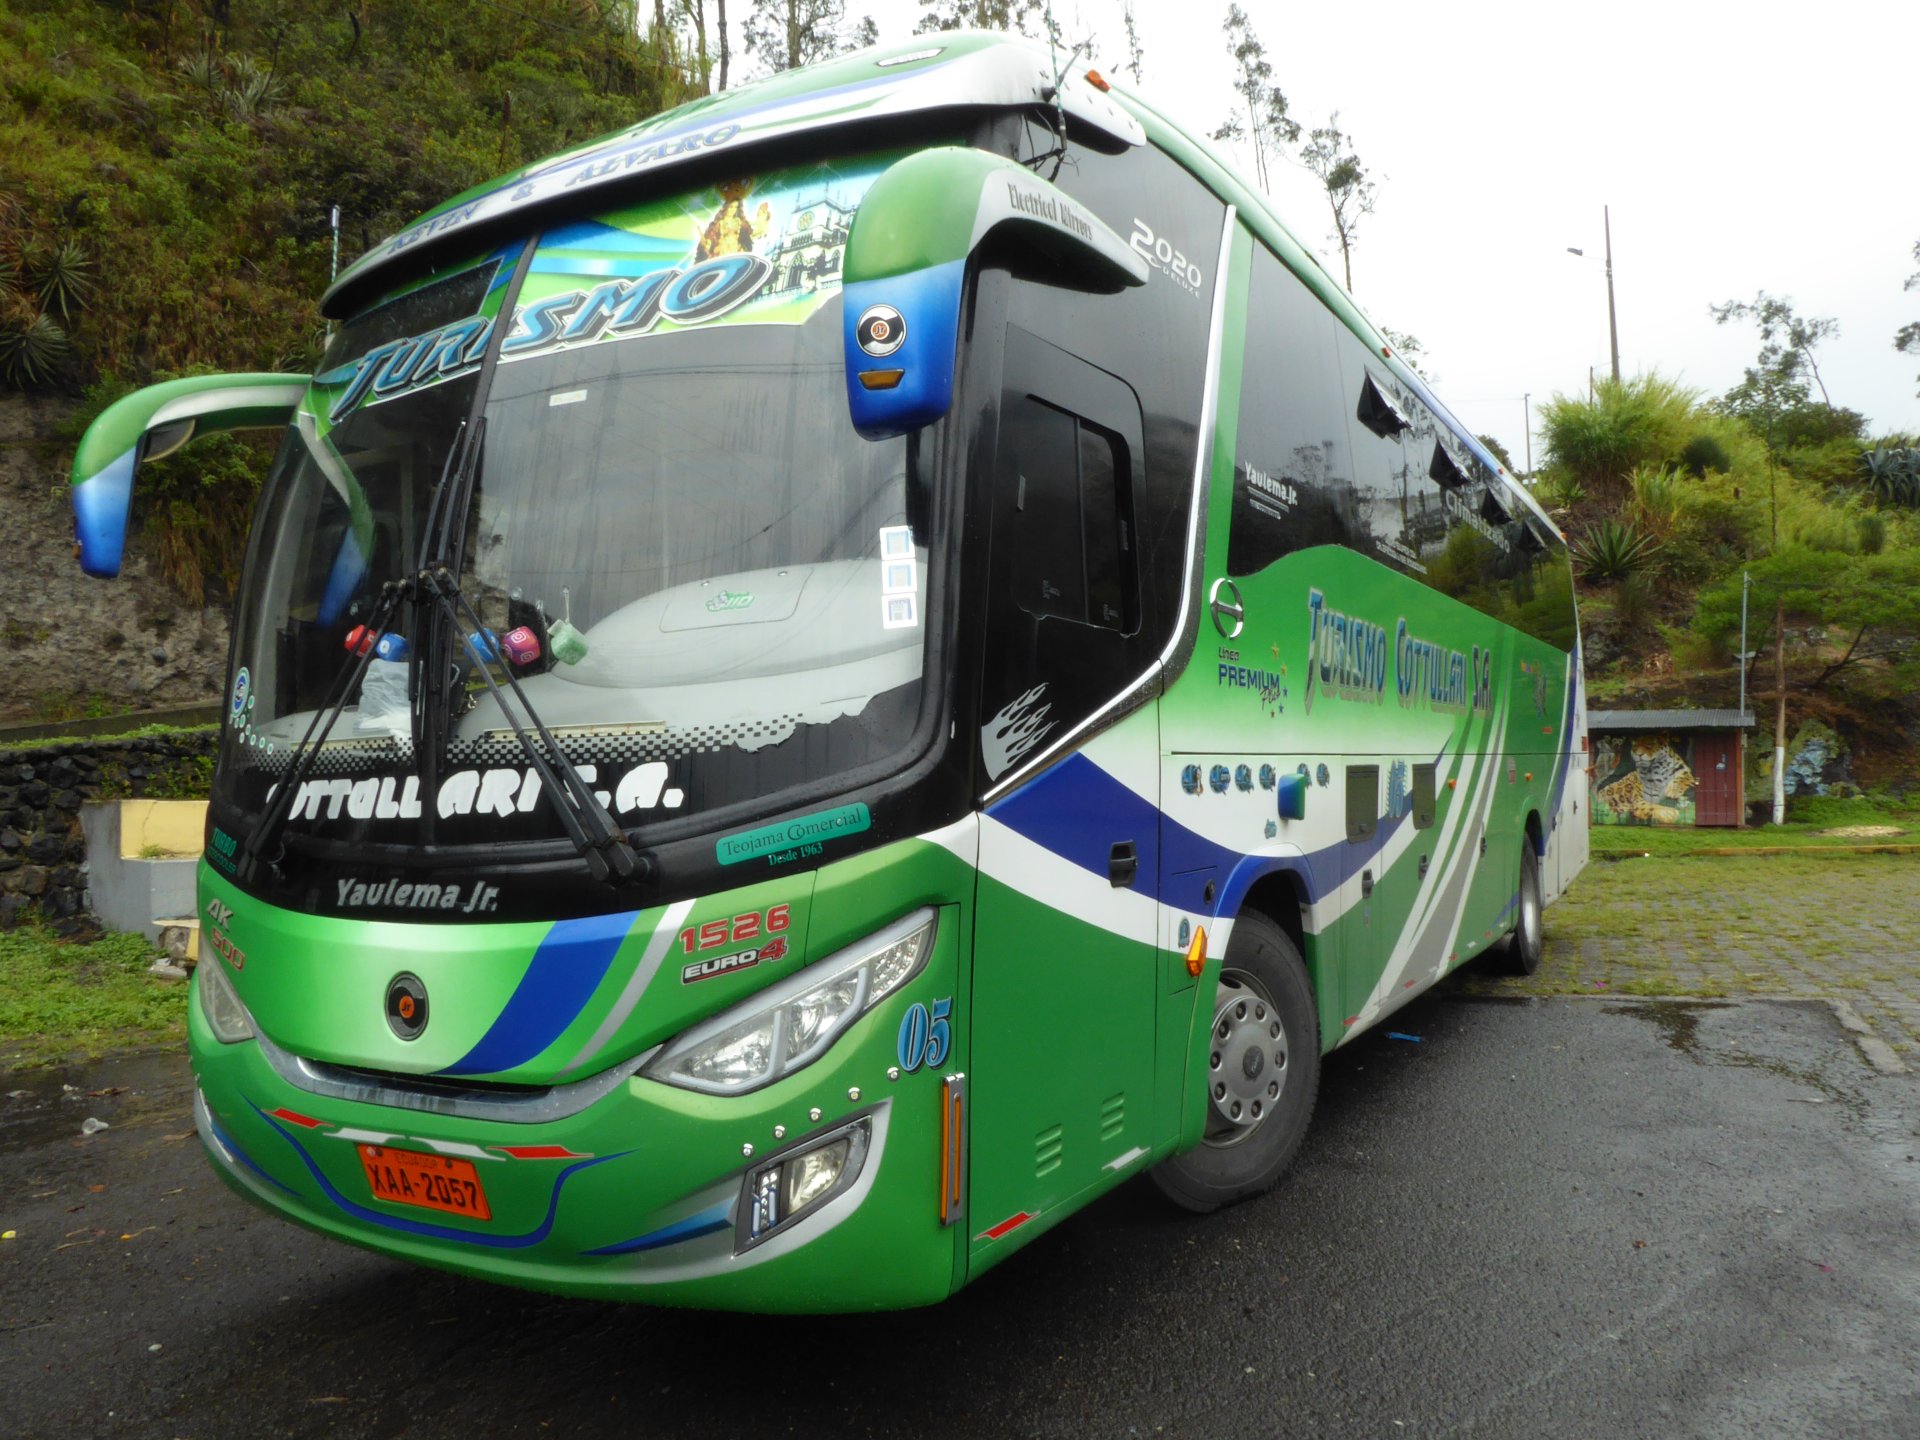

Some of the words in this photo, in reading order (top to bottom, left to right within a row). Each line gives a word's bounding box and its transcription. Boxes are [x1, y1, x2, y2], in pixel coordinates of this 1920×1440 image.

[511, 183, 536, 201] &
[565, 125, 742, 187] ALVARO
[1007, 183, 1058, 222] Electrical
[1130, 217, 1202, 288] 2020
[329, 253, 772, 425] TURISMO
[1245, 460, 1287, 501] Yaulema
[1304, 586, 1387, 710] TURISMO
[1218, 663, 1280, 692] PREMIUM
[723, 831, 784, 857] Teojama
[787, 808, 863, 841] Comercial
[768, 850, 798, 867] Desde
[800, 842, 824, 860] 1963
[207, 898, 234, 932] AK
[337, 878, 459, 909] Yaulema
[463, 881, 499, 914] Jr.
[212, 927, 245, 971] 500
[680, 904, 790, 954] 1526
[897, 996, 952, 1074] 05
[368, 1163, 478, 1211] XAA-2057
